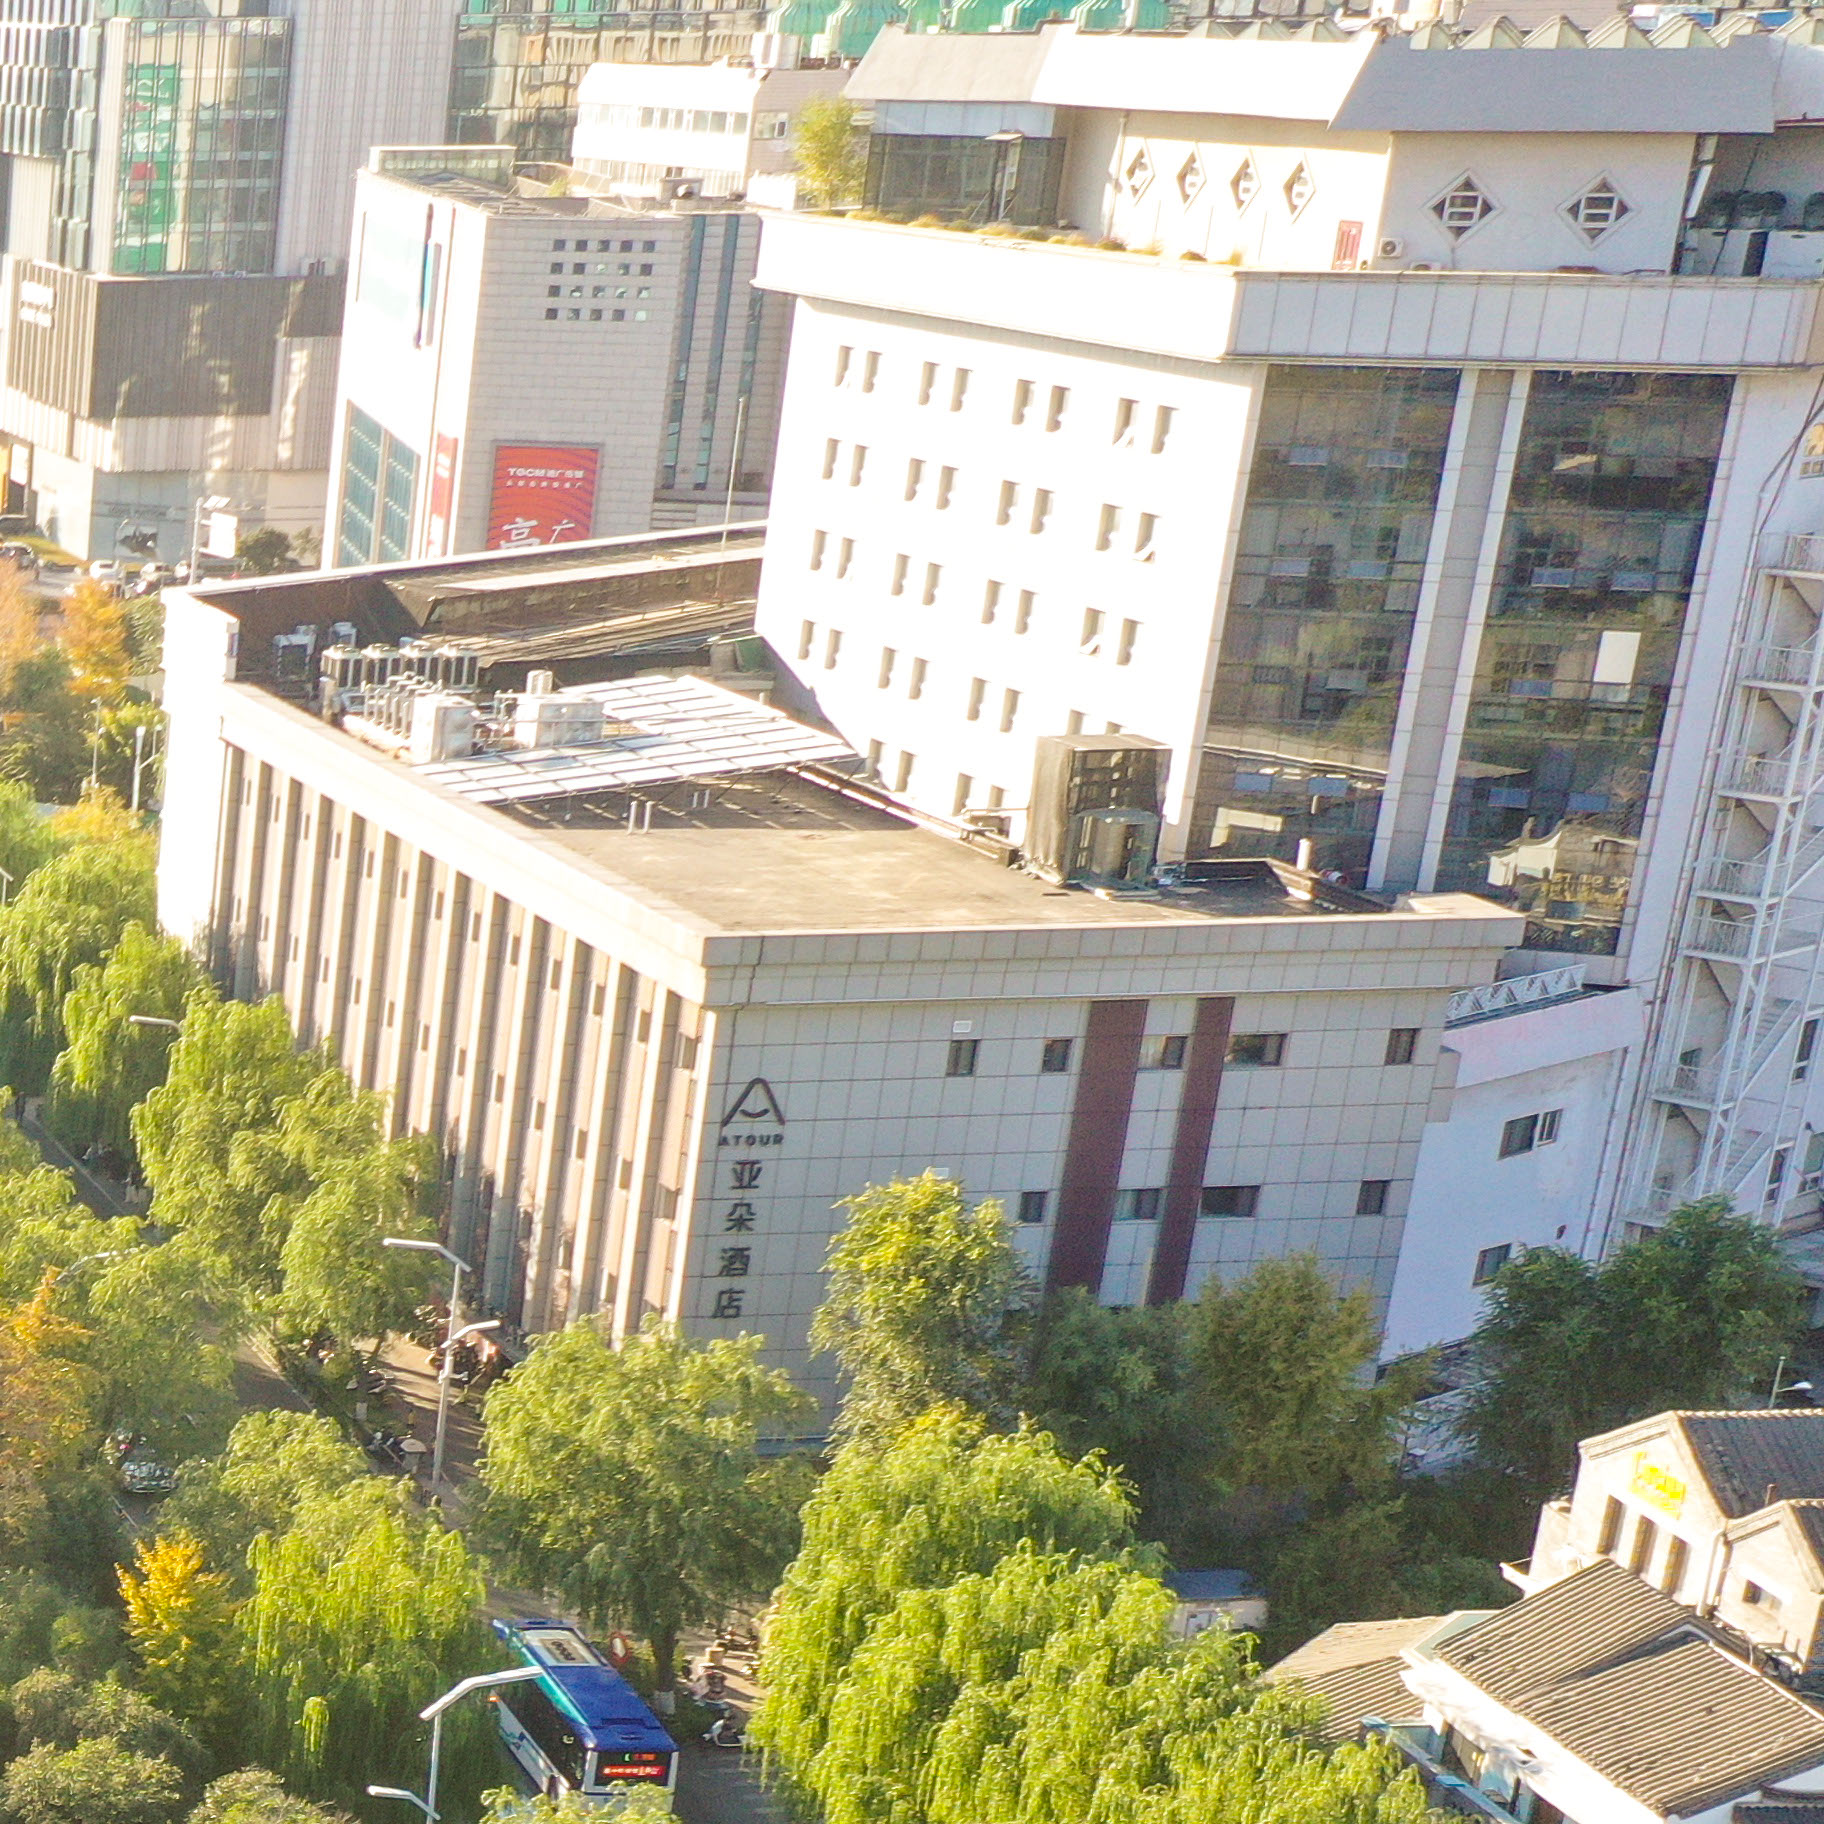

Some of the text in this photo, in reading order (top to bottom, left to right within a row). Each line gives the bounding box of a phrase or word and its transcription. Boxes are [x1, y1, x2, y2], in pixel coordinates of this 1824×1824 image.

[718, 1133, 785, 1147] ATOUR
[712, 1159, 763, 1319] 亚朵酒店
